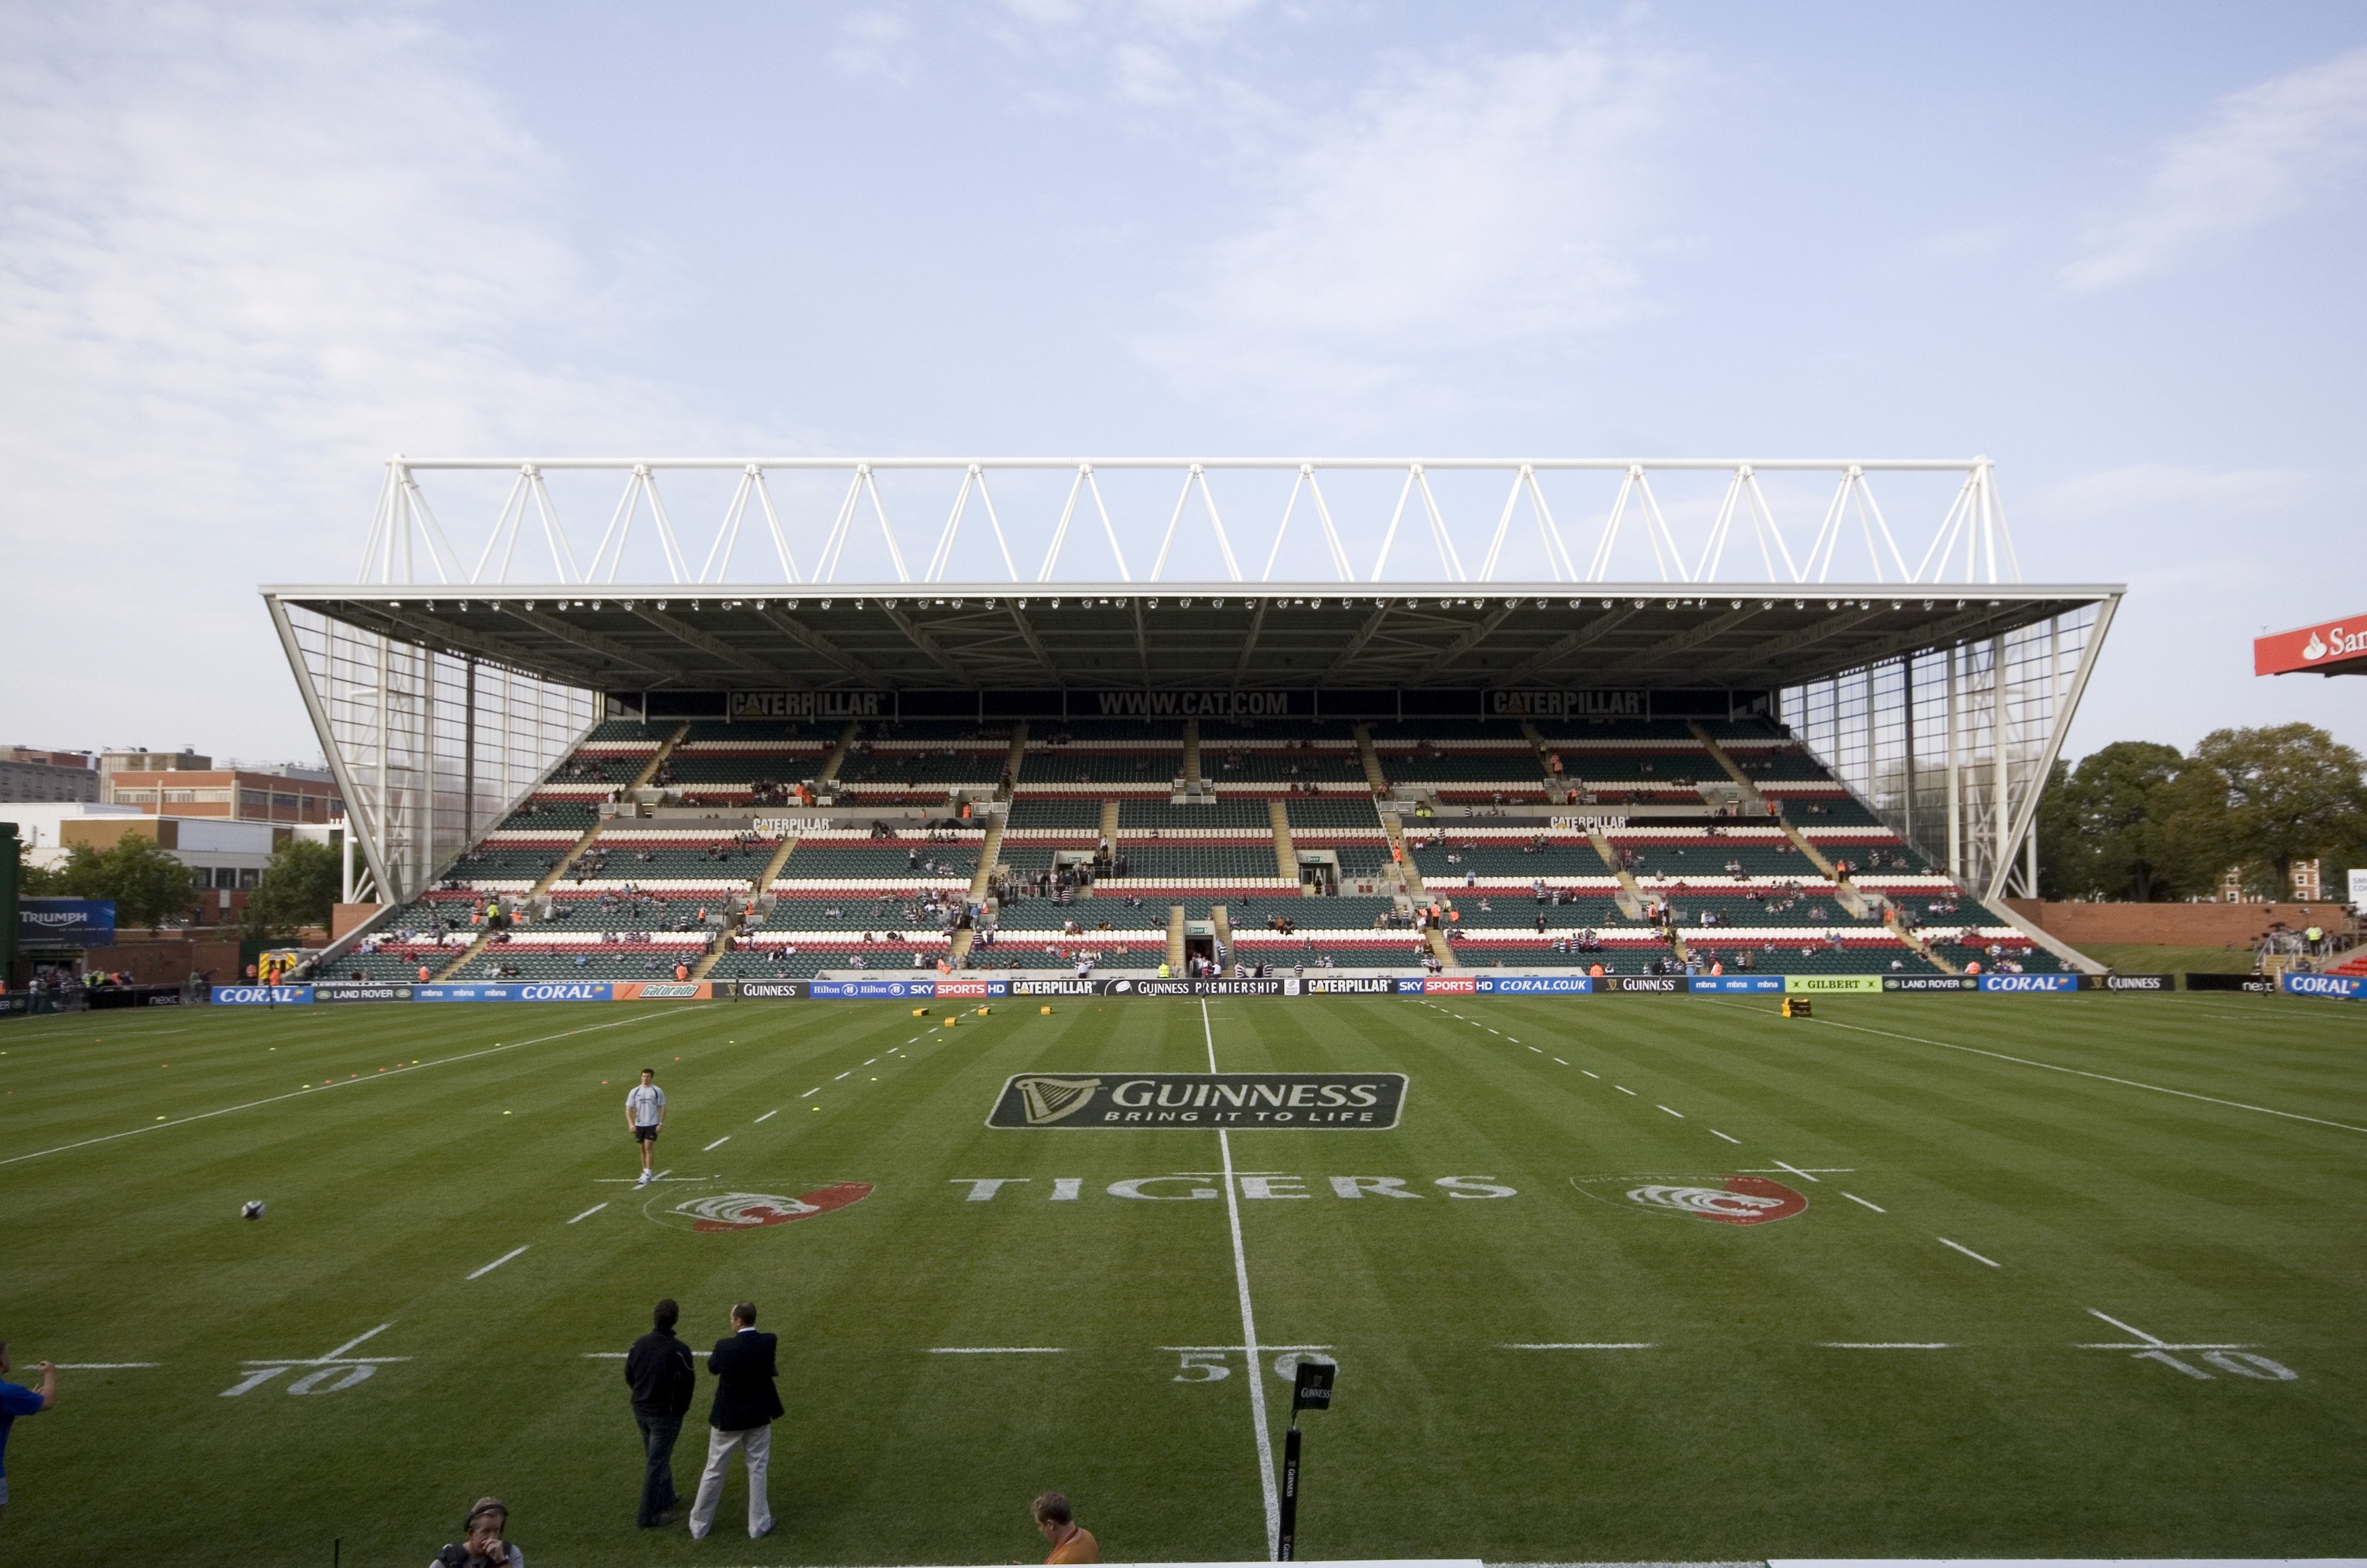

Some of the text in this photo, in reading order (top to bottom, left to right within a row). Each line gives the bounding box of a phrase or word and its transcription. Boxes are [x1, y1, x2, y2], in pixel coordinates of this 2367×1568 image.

[731, 693, 878, 715] CATERPILLAR
[1099, 692, 1287, 715] WWW.CAT.COM
[1493, 692, 1639, 714] CATERPILLAR
[753, 818, 830, 830] CATERPILLAR
[1550, 817, 1626, 828] CATERPILLAR
[19, 911, 88, 925] TRIUMPH
[1012, 982, 1093, 994] CATERPILLAR
[1137, 981, 1279, 994] GUINNESS PREMIERSHIP
[1308, 979, 1388, 993] CATERPILLAR
[1399, 981, 1493, 990] SKY SPORTS HD
[1500, 979, 1585, 991] CORAL.CO.UK
[1808, 979, 1860, 989] GILBERT
[1901, 979, 1960, 989] LAND ROVER
[1986, 977, 2058, 990] CORAL
[2107, 975, 2161, 990] GUINNESS
[2291, 976, 2351, 994] CORAL
[333, 989, 394, 998] LAND ROVER
[421, 989, 443, 997] mbna
[453, 989, 475, 997] mbna
[521, 985, 593, 998] CORAL
[641, 984, 698, 996] Gatorade
[744, 983, 796, 996] GUINNESS
[813, 985, 840, 994] Hilton
[860, 985, 887, 993] Hilton
[911, 984, 1005, 994] SKY SPORTS HD
[149, 994, 178, 1005] next
[219, 988, 293, 1003] CORAL
[1111, 1079, 1376, 1108] GUINNESS
[1103, 1111, 1374, 1123] BRING IT TO LIFE
[949, 1176, 1518, 1201] TIGERS
[2130, 1349, 2298, 1381] 10
[219, 1364, 378, 1397] 10
[1301, 1387, 1331, 1398] GUINNESS
[1286, 1468, 1296, 1497] GUINNESS
